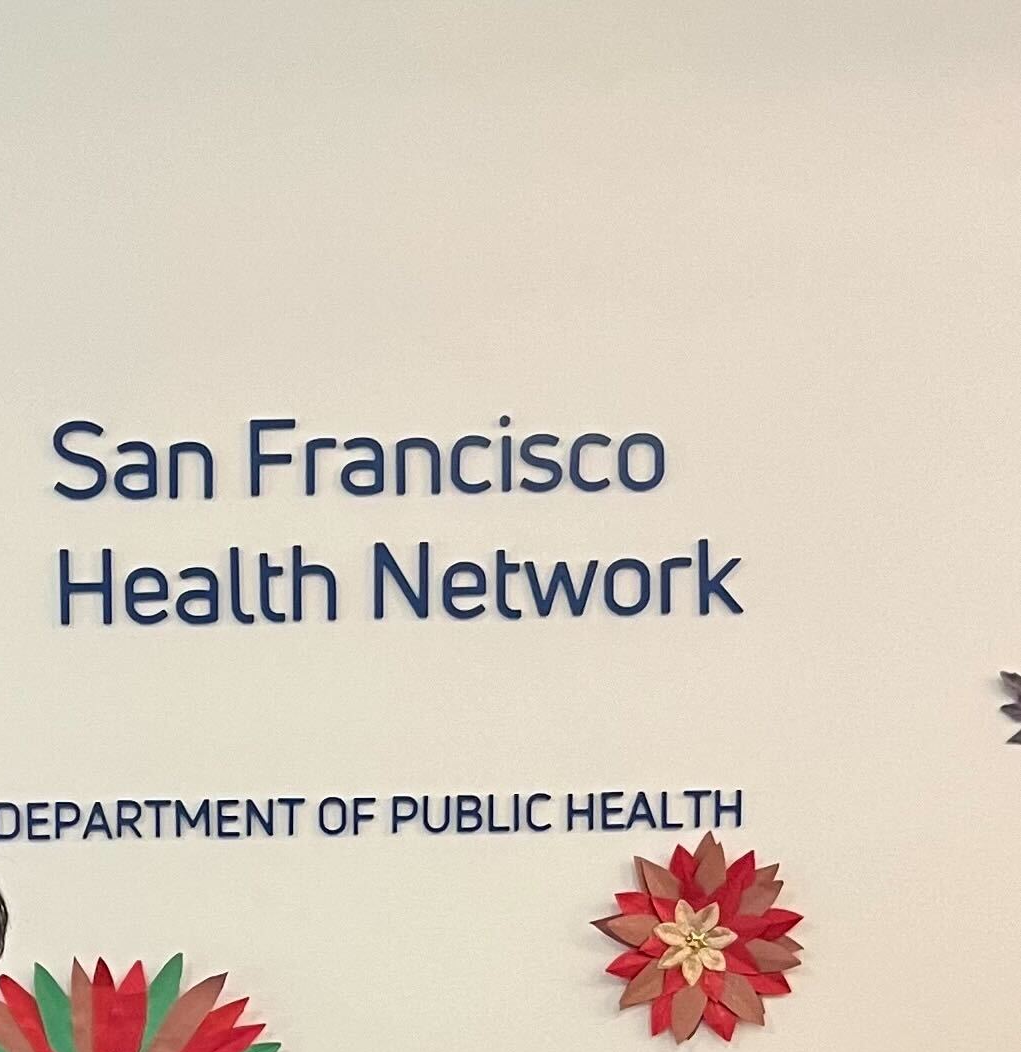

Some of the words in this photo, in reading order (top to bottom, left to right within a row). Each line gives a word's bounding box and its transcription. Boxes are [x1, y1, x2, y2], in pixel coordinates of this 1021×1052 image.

[52, 420, 214, 501] San
[249, 415, 665, 498] Francisco
[59, 544, 337, 626] Health
[373, 538, 744, 620] Network
[318, 796, 377, 836] OF
[391, 792, 552, 834] PUBLIC
[567, 789, 742, 832] HEALTH
